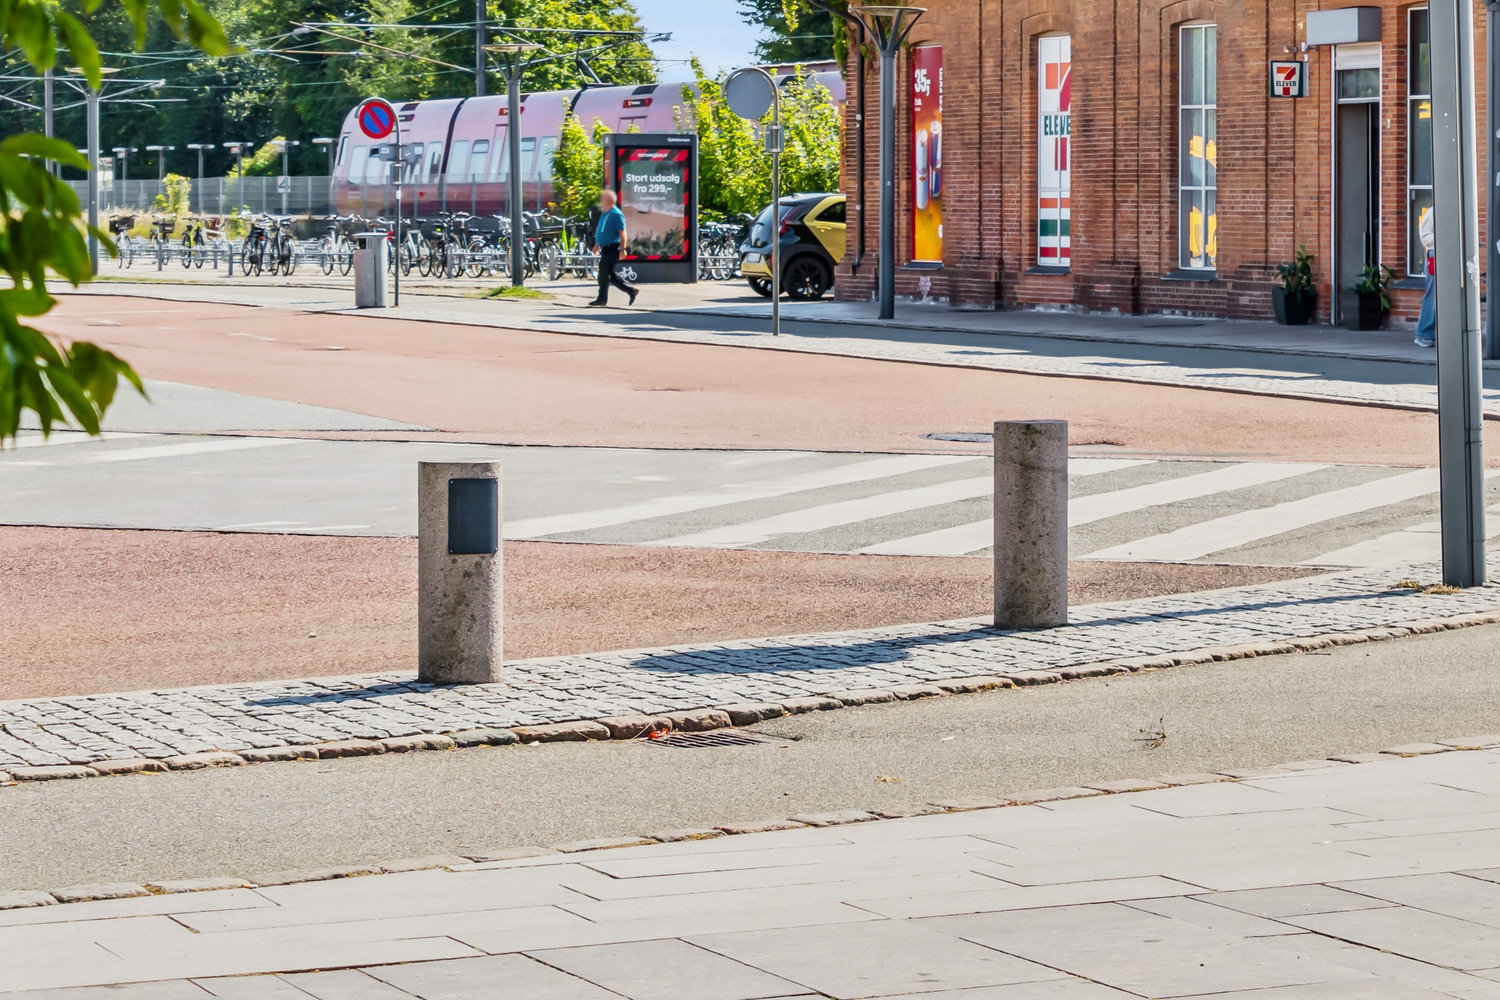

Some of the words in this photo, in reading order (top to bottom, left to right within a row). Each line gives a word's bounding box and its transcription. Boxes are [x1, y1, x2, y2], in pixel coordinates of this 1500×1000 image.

[1043, 115, 1071, 135] ELEVE
[625, 173, 648, 182] Stort
[649, 173, 680, 184] udsalg
[633, 184, 647, 193] fra
